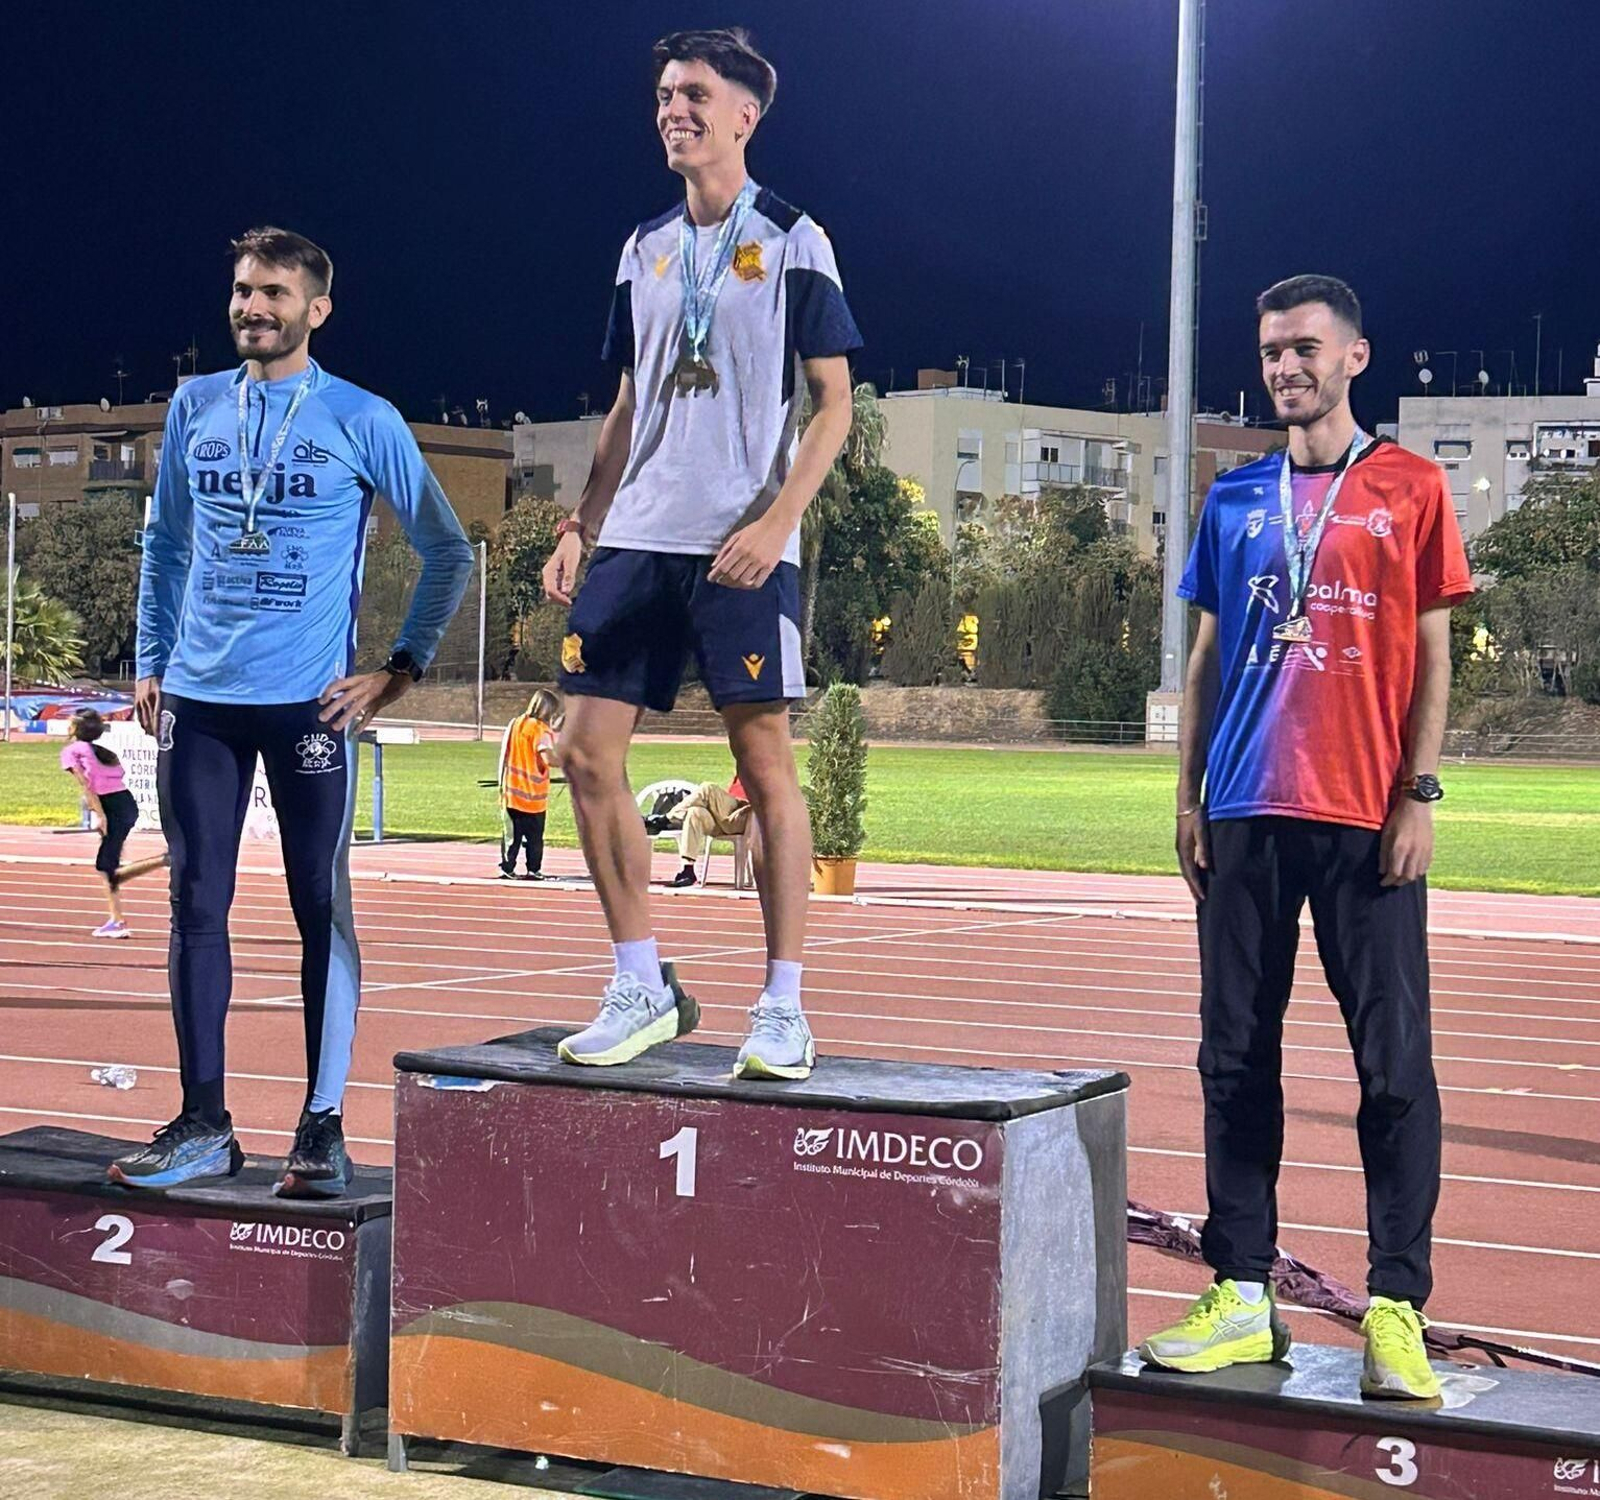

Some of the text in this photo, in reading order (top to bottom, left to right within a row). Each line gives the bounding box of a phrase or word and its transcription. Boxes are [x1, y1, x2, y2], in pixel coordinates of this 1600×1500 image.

[659, 1126, 697, 1197] 1
[793, 1161, 832, 1174] Instituto
[832, 1164, 878, 1180] Municipal
[879, 1168, 892, 1181] de
[836, 1128, 983, 1172] IMDECO
[91, 1214, 135, 1265] 2
[256, 1223, 345, 1251] IMDECO
[1375, 1436, 1419, 1486] 3
